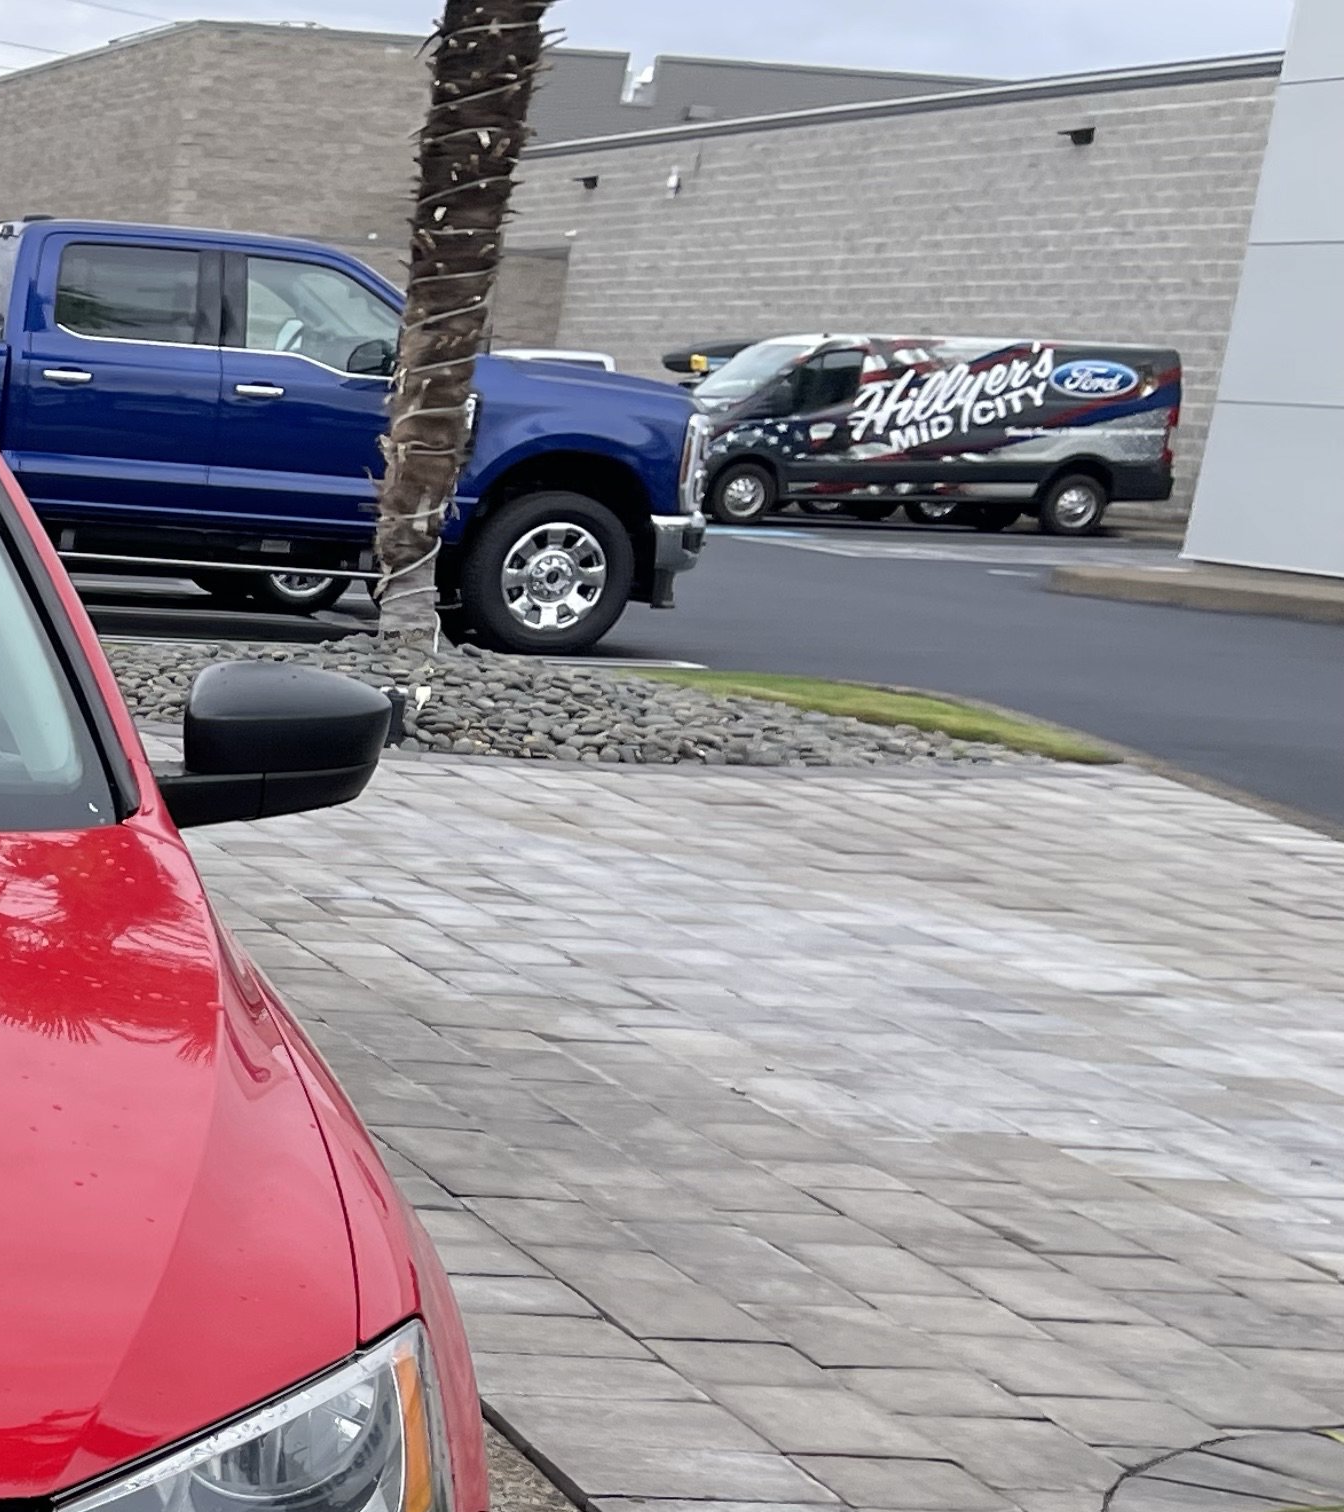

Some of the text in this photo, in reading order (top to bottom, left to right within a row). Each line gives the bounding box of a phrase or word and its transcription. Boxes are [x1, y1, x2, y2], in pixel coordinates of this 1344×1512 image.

[849, 342, 1122, 441] Hillyer's Ford
[887, 382, 1049, 453] MID CITY
